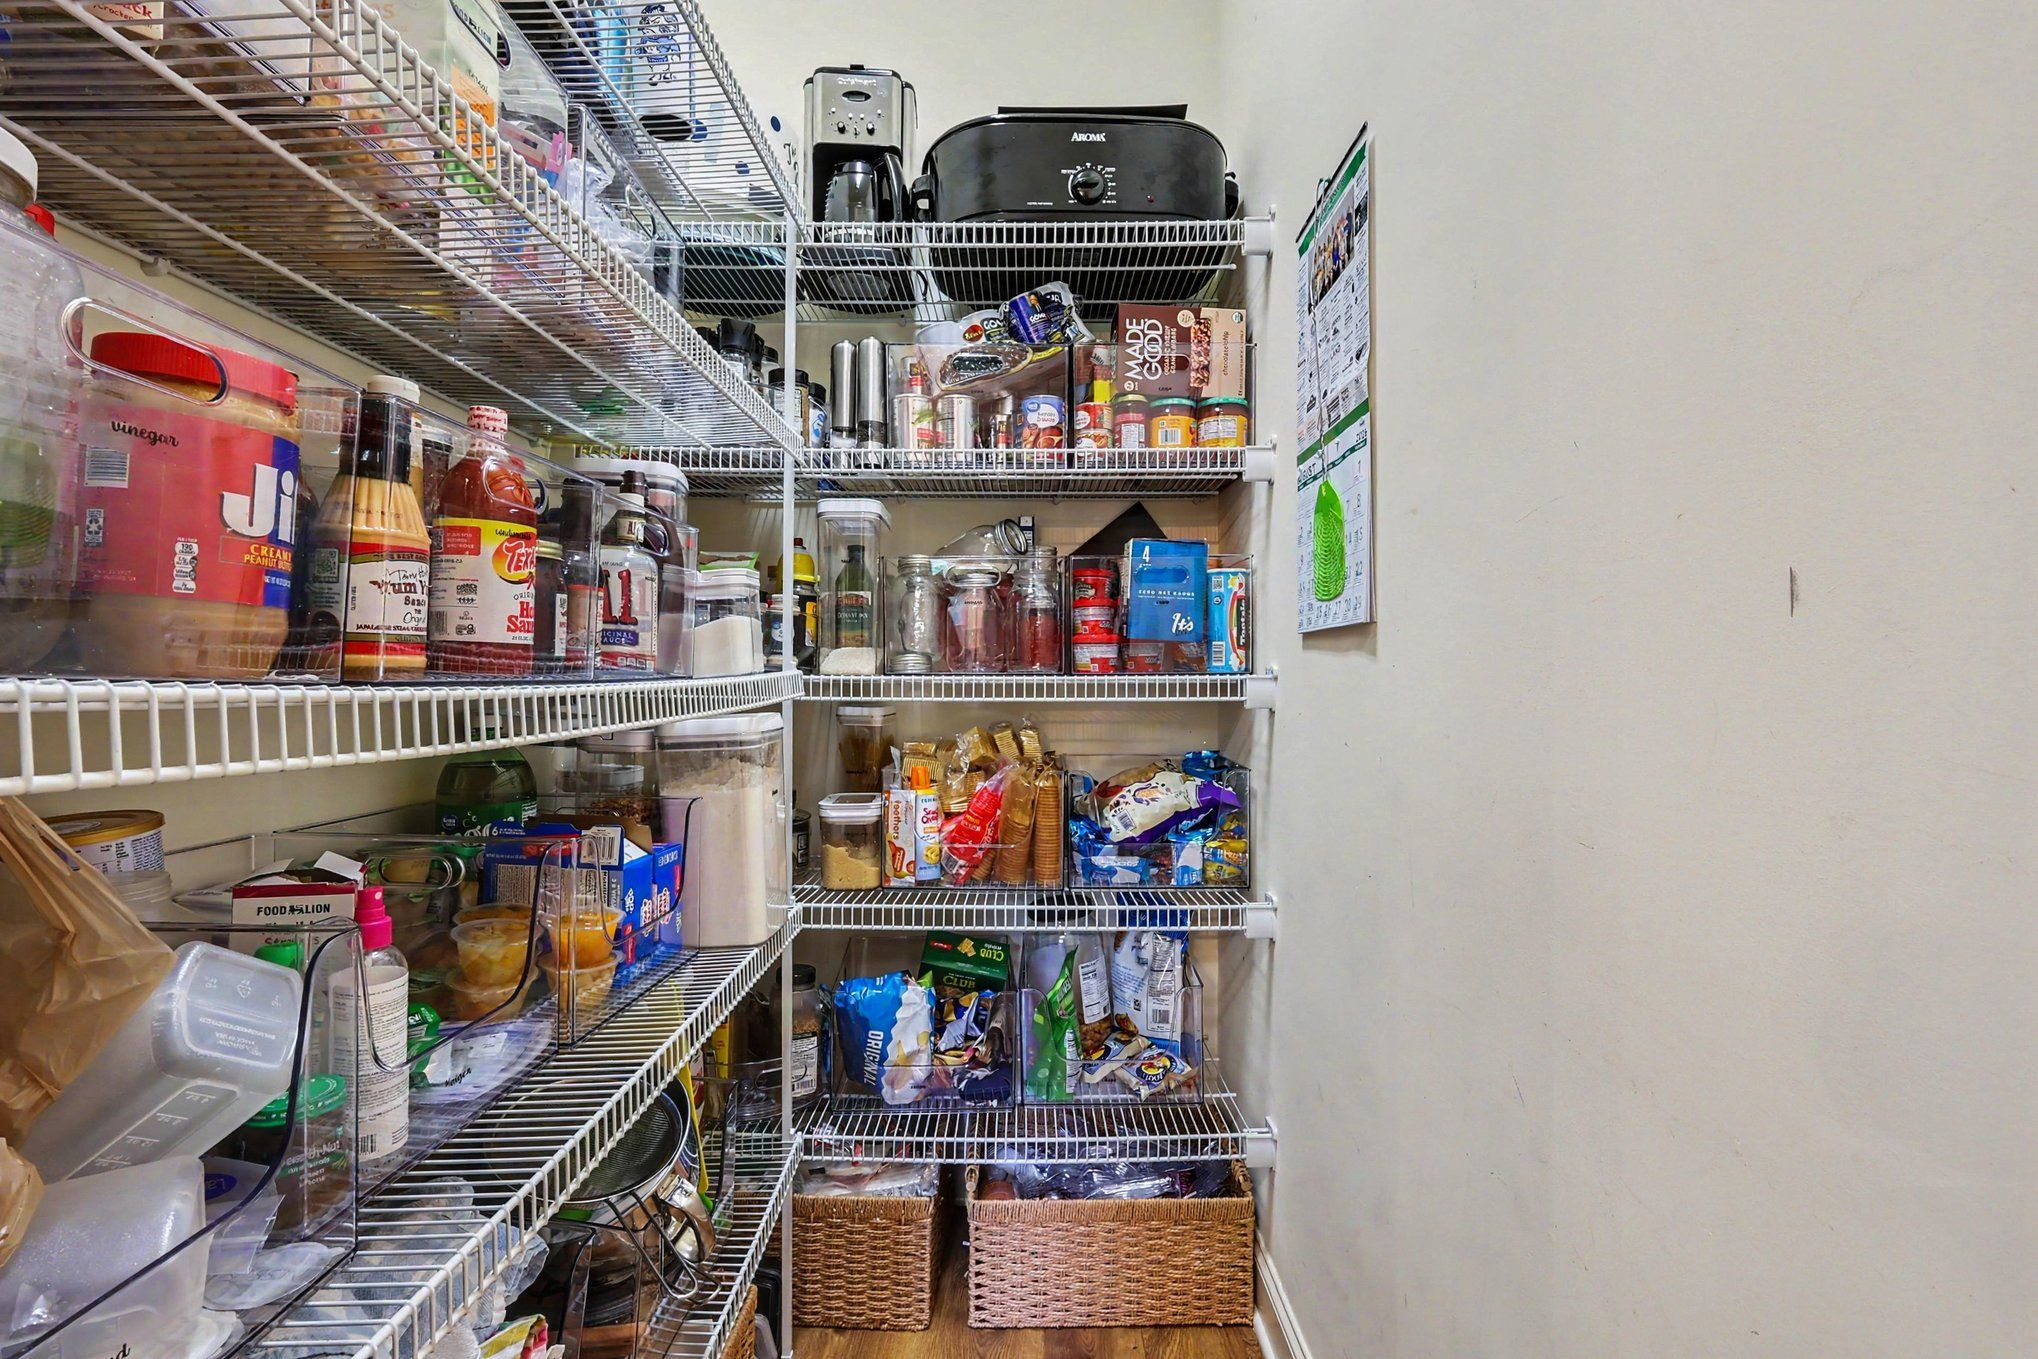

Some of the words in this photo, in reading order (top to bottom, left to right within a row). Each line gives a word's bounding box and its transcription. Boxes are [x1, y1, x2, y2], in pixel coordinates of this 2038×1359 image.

[1071, 131, 1106, 142] AROMA
[1125, 318, 1144, 380] MADE
[1143, 318, 1162, 380] GOOD
[111, 420, 179, 447] vinegar
[243, 553, 277, 568] PEANUT
[1142, 545, 1150, 562] 4
[257, 905, 287, 916] FOOD
[305, 903, 331, 914] LION
[863, 1029, 885, 1086] ORIGINAL
